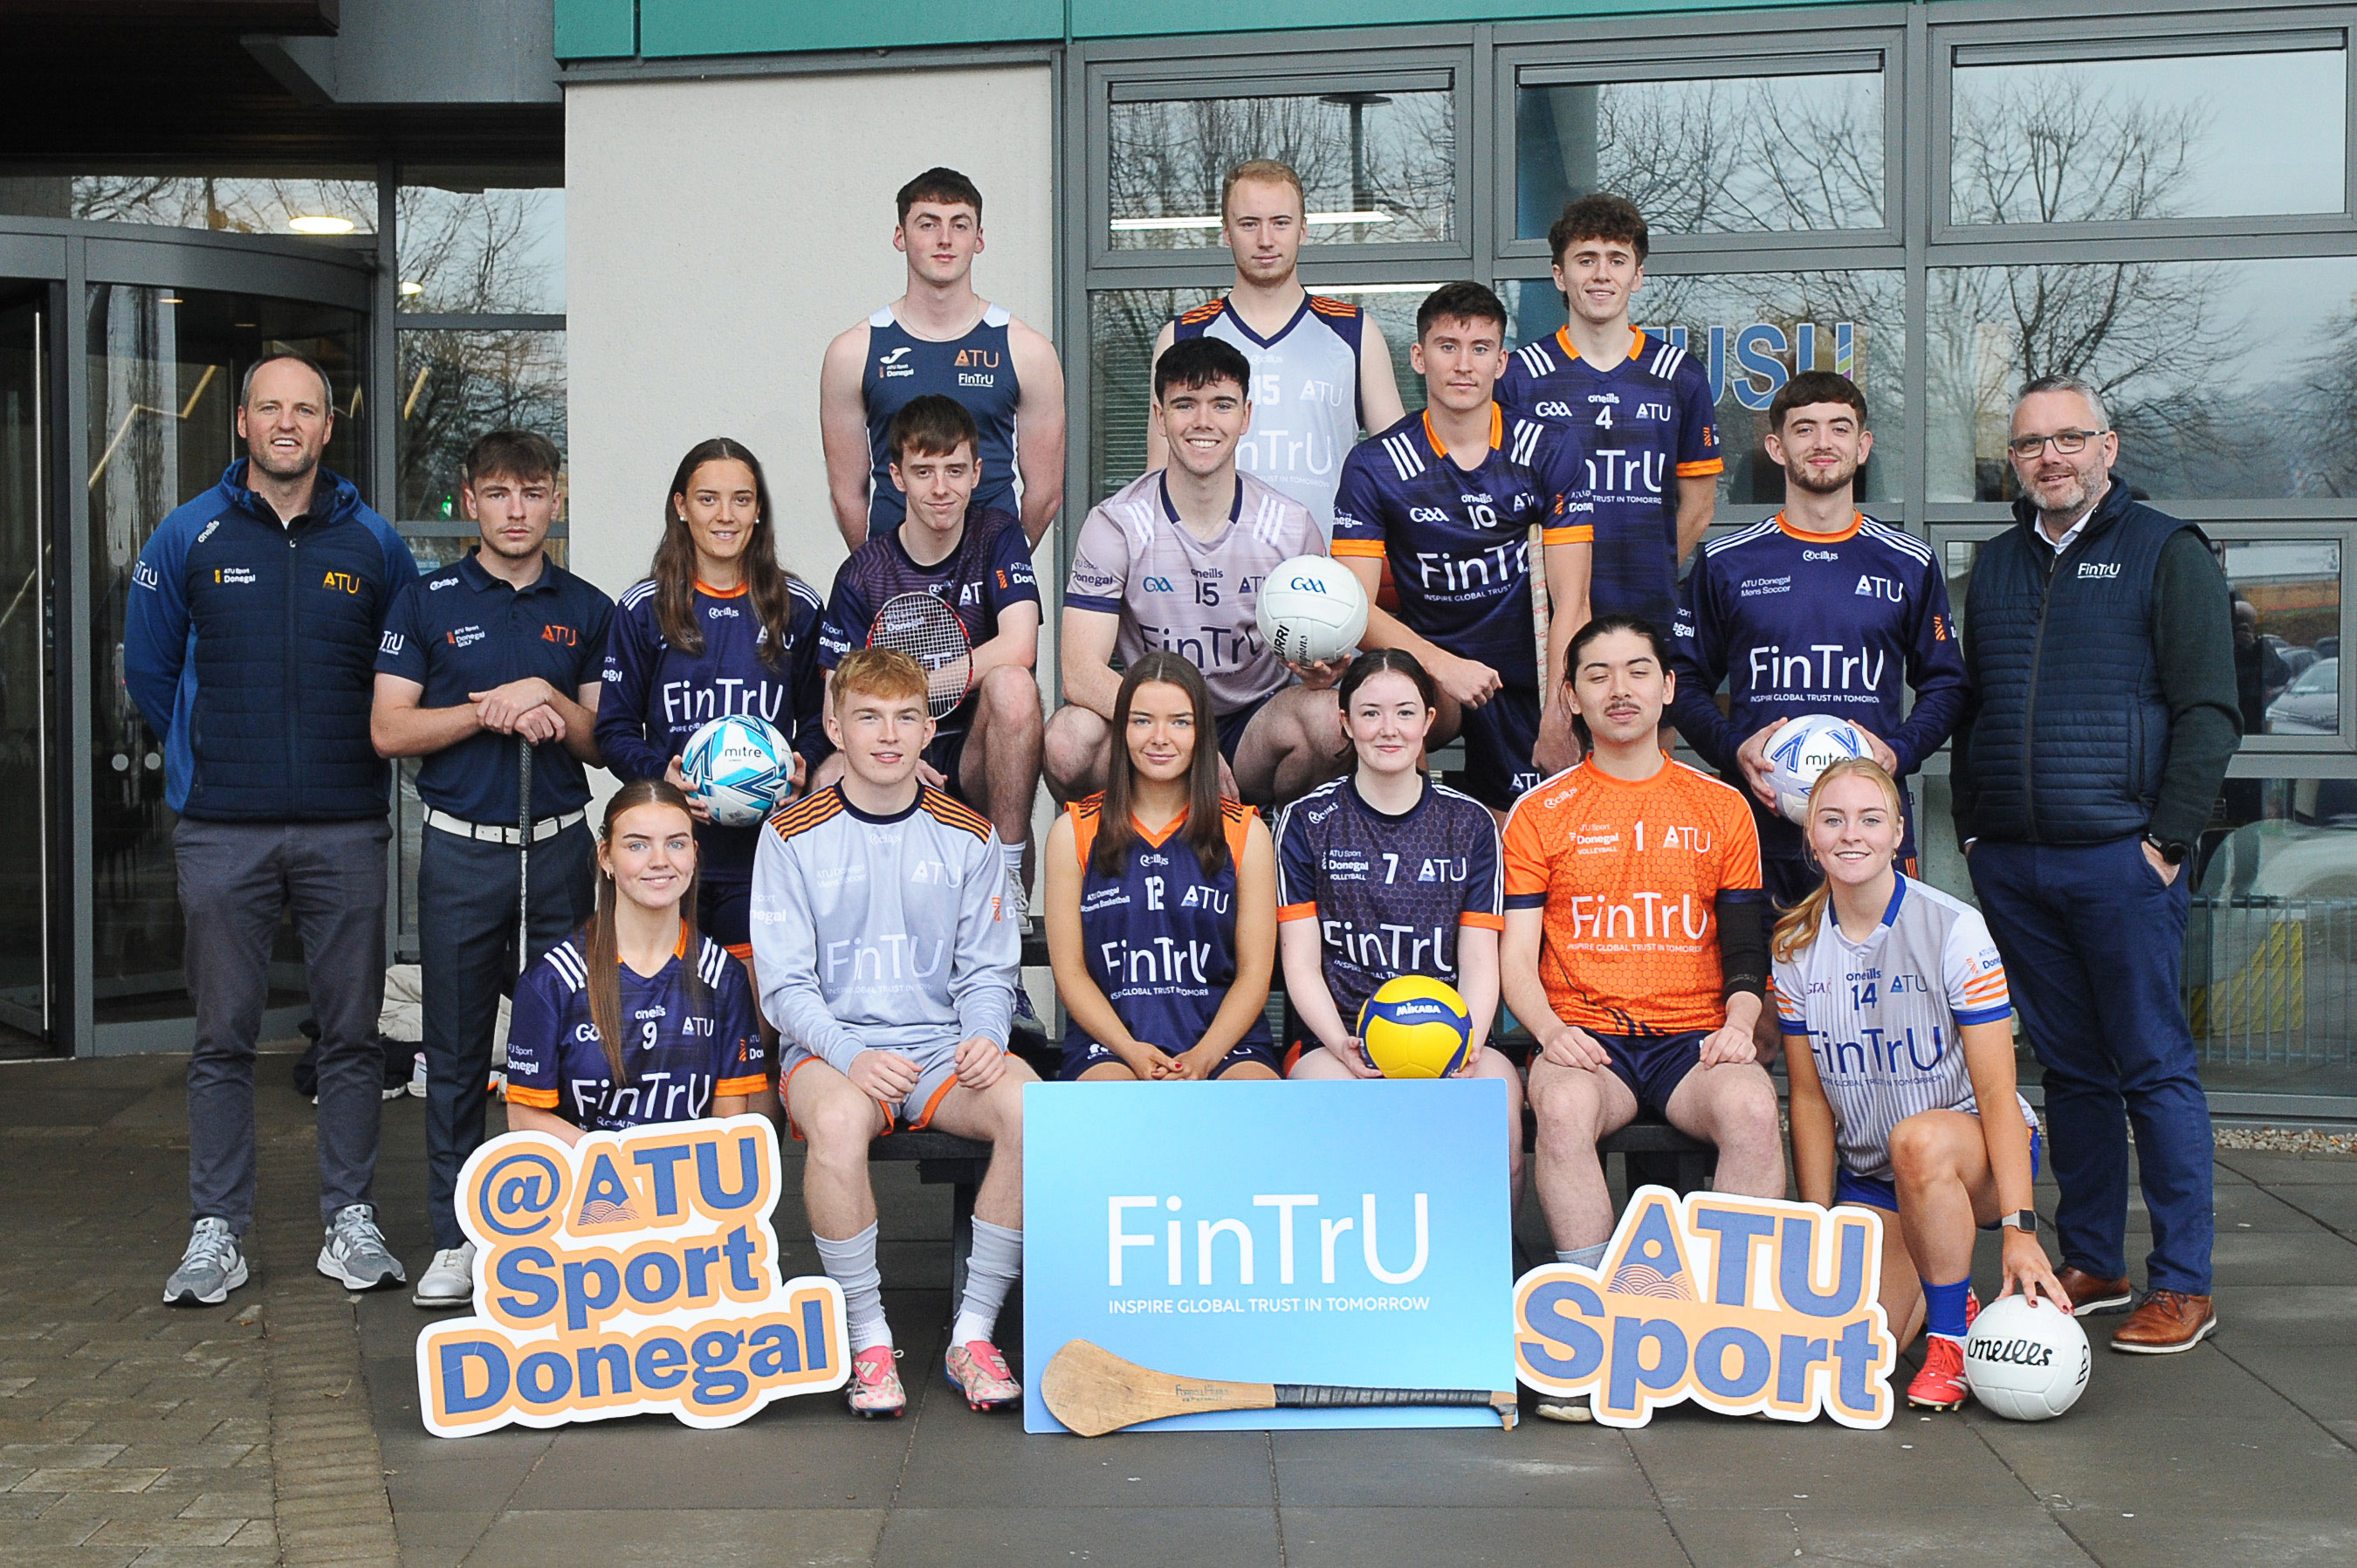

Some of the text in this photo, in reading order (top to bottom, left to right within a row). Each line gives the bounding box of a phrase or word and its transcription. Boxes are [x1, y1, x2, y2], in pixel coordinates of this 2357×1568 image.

[953, 349, 1000, 368] ATU
[1641, 322, 1853, 410] USU
[959, 373, 993, 385] FinTrU
[1254, 374, 1280, 406] 15
[1300, 379, 1343, 407] ATU
[1595, 405, 1613, 430] 4
[1636, 402, 1671, 422] ATU
[1235, 430, 1333, 475] nTrU
[1584, 449, 1666, 492] nTrU
[1592, 494, 1615, 503] TRUST
[1626, 496, 1662, 505] TOMORRO
[1467, 505, 1497, 530] 10
[223, 574, 256, 584] Donegal
[322, 571, 360, 594] ATU
[1741, 575, 1791, 588] ATU Donegal
[2078, 563, 2120, 577] FinTrU
[1195, 581, 1220, 607] 15
[1239, 576, 1266, 593] AT
[1454, 592, 1486, 602] GLOBAL
[1763, 585, 1791, 595] Soccer
[1855, 574, 1904, 602] ATU
[379, 629, 404, 651] TrU
[456, 630, 485, 643] Donegal
[541, 624, 576, 646] ATU
[756, 625, 794, 650] AU
[1274, 624, 1290, 658] URRI
[1298, 635, 1312, 663] pions
[1749, 644, 1884, 691] FinTrU
[663, 678, 783, 723] FinTrU
[1773, 693, 1805, 702] GLOBAL
[1806, 693, 1832, 702] TRUST
[725, 746, 762, 758] mitre
[1577, 832, 1619, 845] Donegal
[1634, 820, 1644, 851] 1
[1663, 825, 1711, 853] ATU
[1345, 849, 1362, 858] Sport
[1577, 846, 1618, 855] VOLLEYBALL
[911, 860, 961, 888] ATU
[1329, 860, 1369, 871] Donegal
[1383, 853, 1399, 884] 7
[1418, 856, 1467, 883] ATU
[1144, 876, 1165, 911] 12
[1180, 885, 1229, 914] ATU
[1571, 892, 1708, 940] FinTrU
[1596, 943, 1630, 952] GLOBAL
[1632, 943, 1657, 952] TRUST
[1657, 943, 1666, 952] IN
[1101, 937, 1211, 984] FinTrU
[1122, 987, 1152, 996] GLOBAL
[1153, 986, 1175, 994] TRUST
[1851, 982, 1877, 1010] 14
[1890, 975, 1928, 993] ATU
[1396, 1002, 1441, 1016] MIKASA
[643, 1021, 656, 1049] 9
[682, 1017, 714, 1037] ATU
[515, 1044, 533, 1056] Sport
[1894, 1074, 1945, 1087] TOMORROW
[572, 1072, 710, 1119] FinTrU
[479, 1137, 759, 1236] @ATU
[1108, 1193, 1429, 1286] FinTrU
[1608, 1202, 1866, 1317] ATU
[497, 1224, 759, 1331] Sport
[1109, 1296, 1430, 1314] INSPIRE GLOBAL TRUST IN TOMORROW
[440, 1300, 827, 1415] Donegal
[1521, 1280, 1878, 1412] Sport
